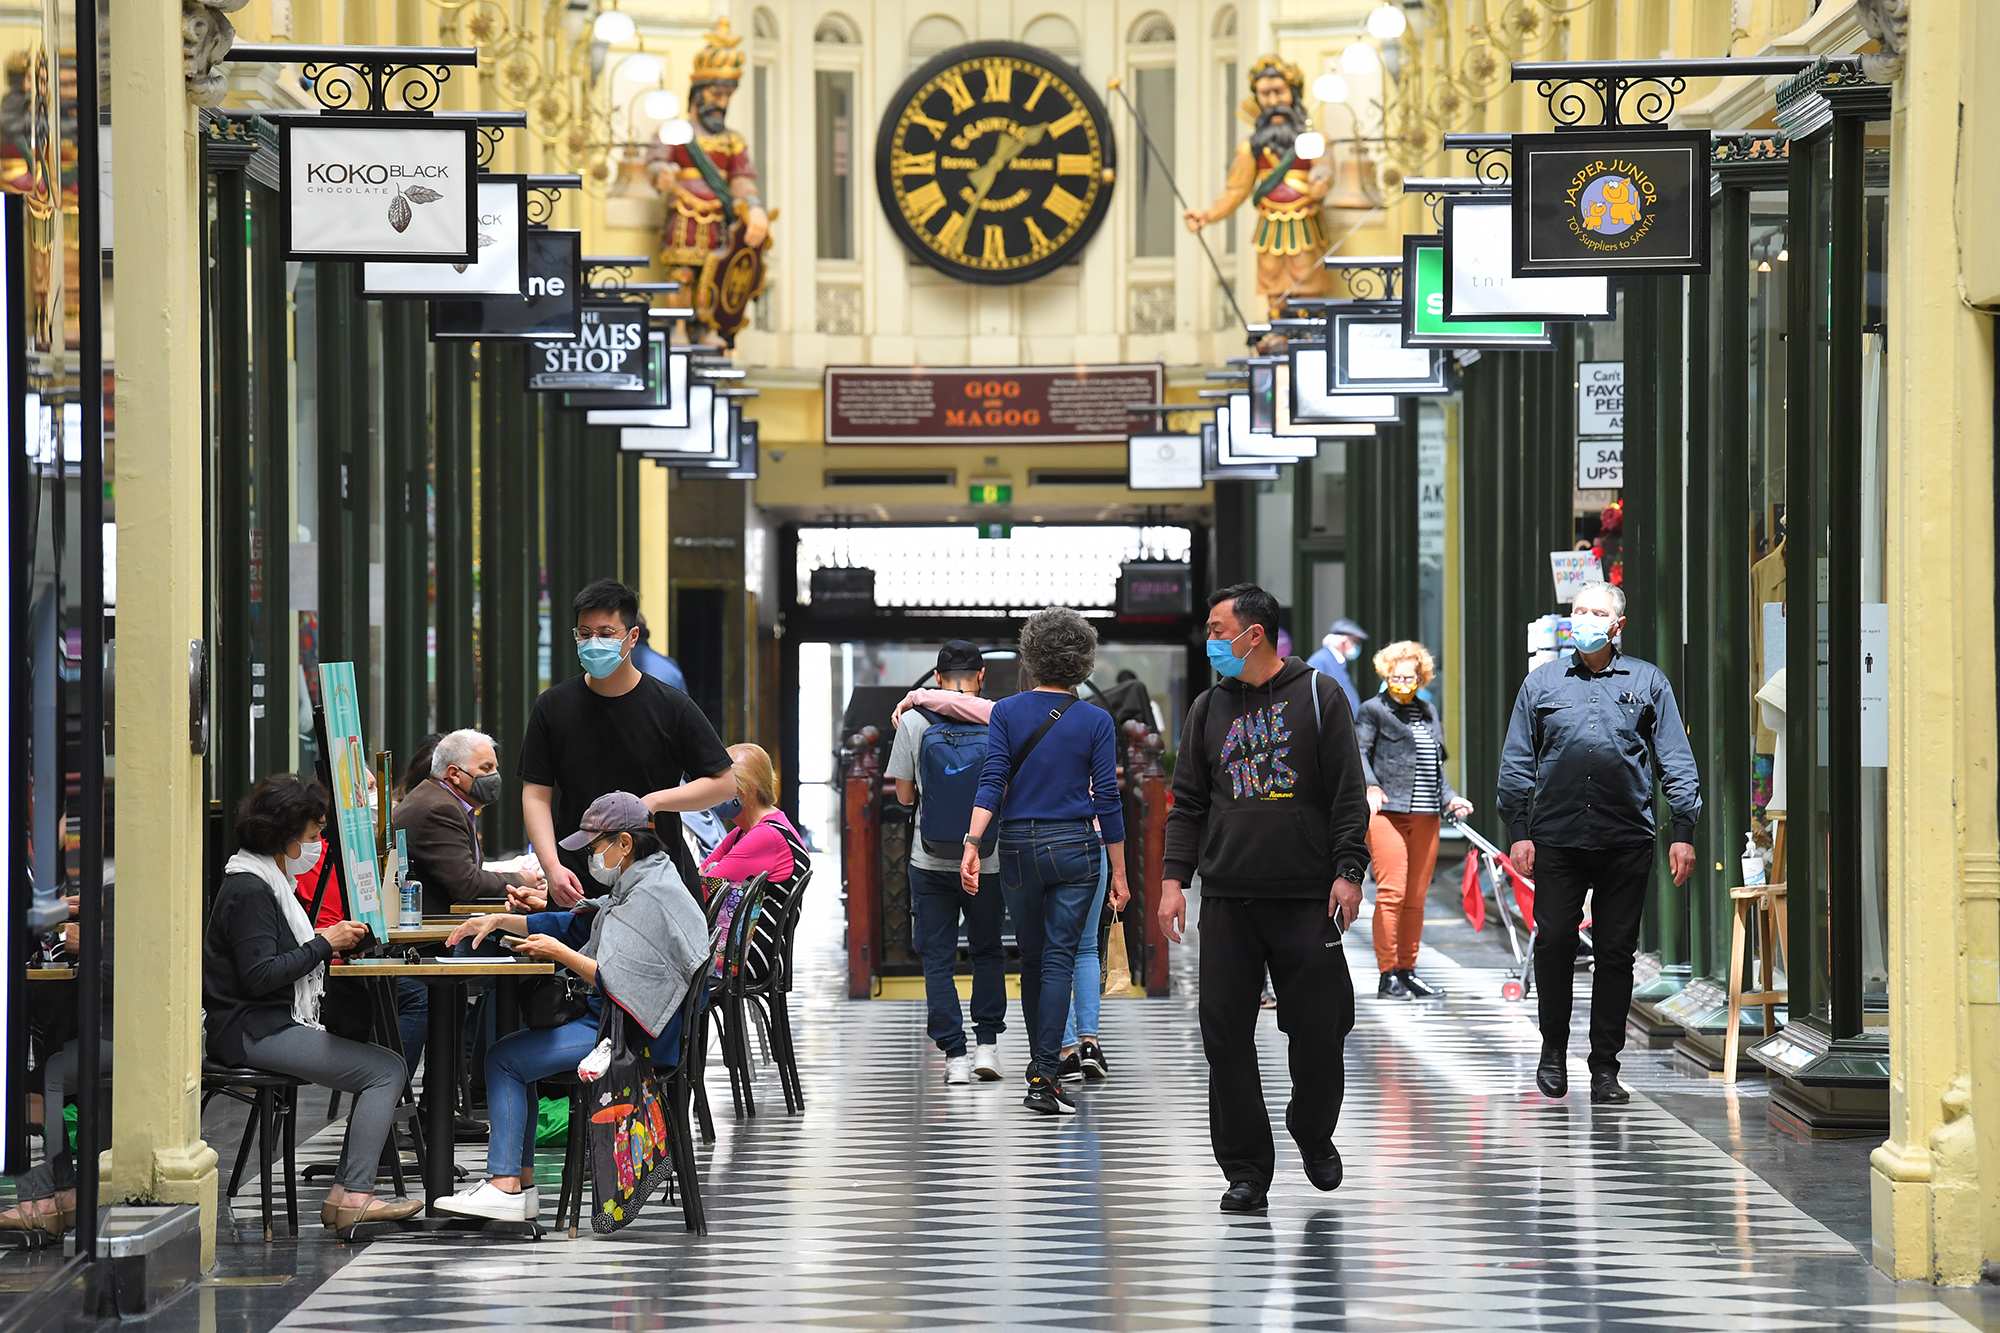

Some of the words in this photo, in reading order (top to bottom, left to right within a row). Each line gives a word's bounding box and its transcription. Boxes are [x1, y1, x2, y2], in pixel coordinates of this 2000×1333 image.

[307, 163, 389, 184] KOKO
[390, 165, 449, 178] BLACK
[307, 186, 389, 195] CHOCOLATE
[1564, 160, 1607, 207] JASPER
[1610, 159, 1657, 206] JUNIOR
[1567, 216, 1583, 236] TOY
[1579, 233, 1617, 252] Suppliers
[1620, 241, 1630, 249] to
[1630, 213, 1655, 245] SANTA
[581, 312, 600, 324] HE
[534, 323, 642, 350] MES
[545, 349, 627, 373] SHOP
[1593, 370, 1621, 381] Can't
[964, 381, 1021, 399] GOG
[945, 409, 1040, 427] MAGOG
[1554, 555, 1601, 570] wrapping
[1556, 571, 1584, 584] paper
